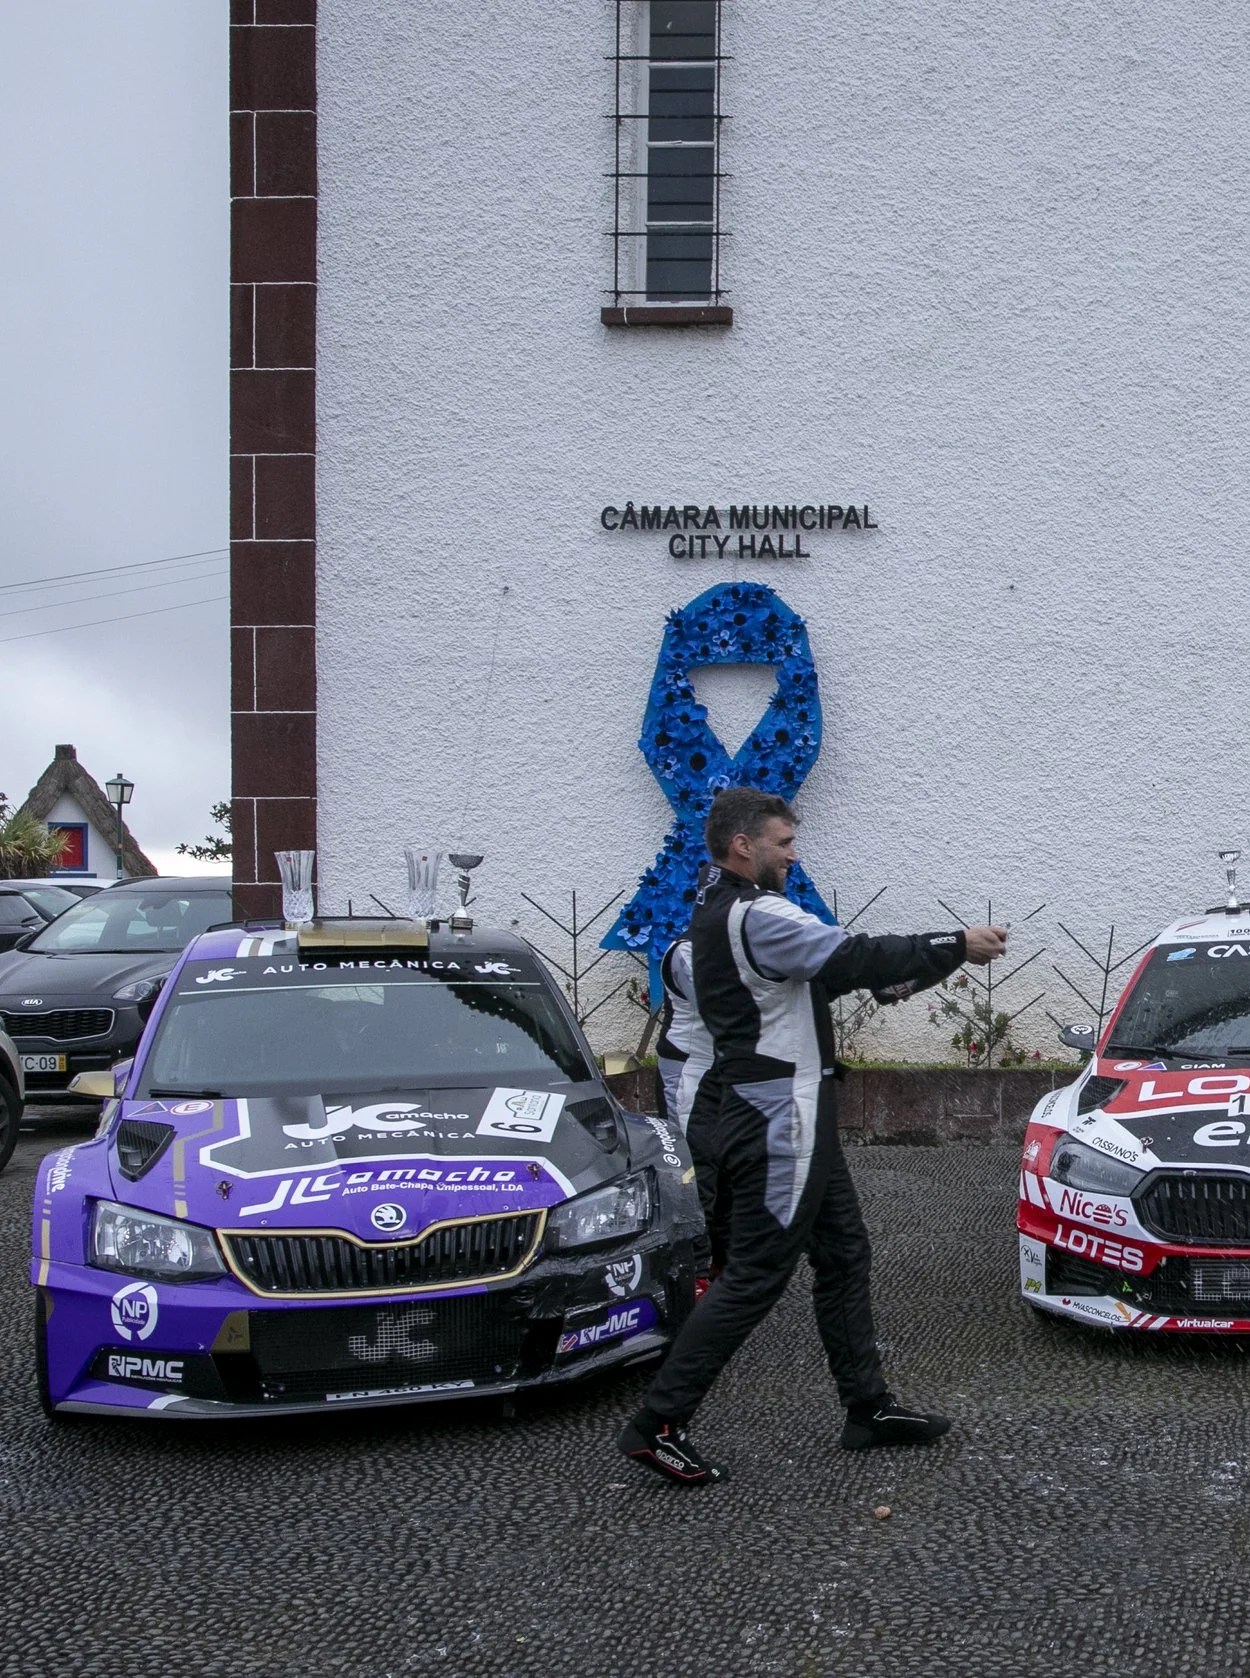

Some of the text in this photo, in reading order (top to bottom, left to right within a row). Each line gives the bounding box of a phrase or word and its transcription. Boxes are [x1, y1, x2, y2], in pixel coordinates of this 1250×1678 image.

[601, 501, 878, 530] CÂMARA MUNICIPAL
[668, 533, 811, 559] CITY HALL
[263, 958, 462, 975] AUTO MECÂNICA
[1231, 1094, 1247, 1114] 1
[284, 1130, 476, 1150] AUTO MECÂNICA
[342, 1181, 524, 1196] Auto Bate-Chapa Unipessoal, LDA
[1053, 1224, 1144, 1272] LOTES
[122, 1299, 148, 1318] NP
[1073, 1301, 1121, 1322] MVASCONCELOS
[1176, 1319, 1234, 1329] virtualcar
[655, 1449, 685, 1469] sparco
